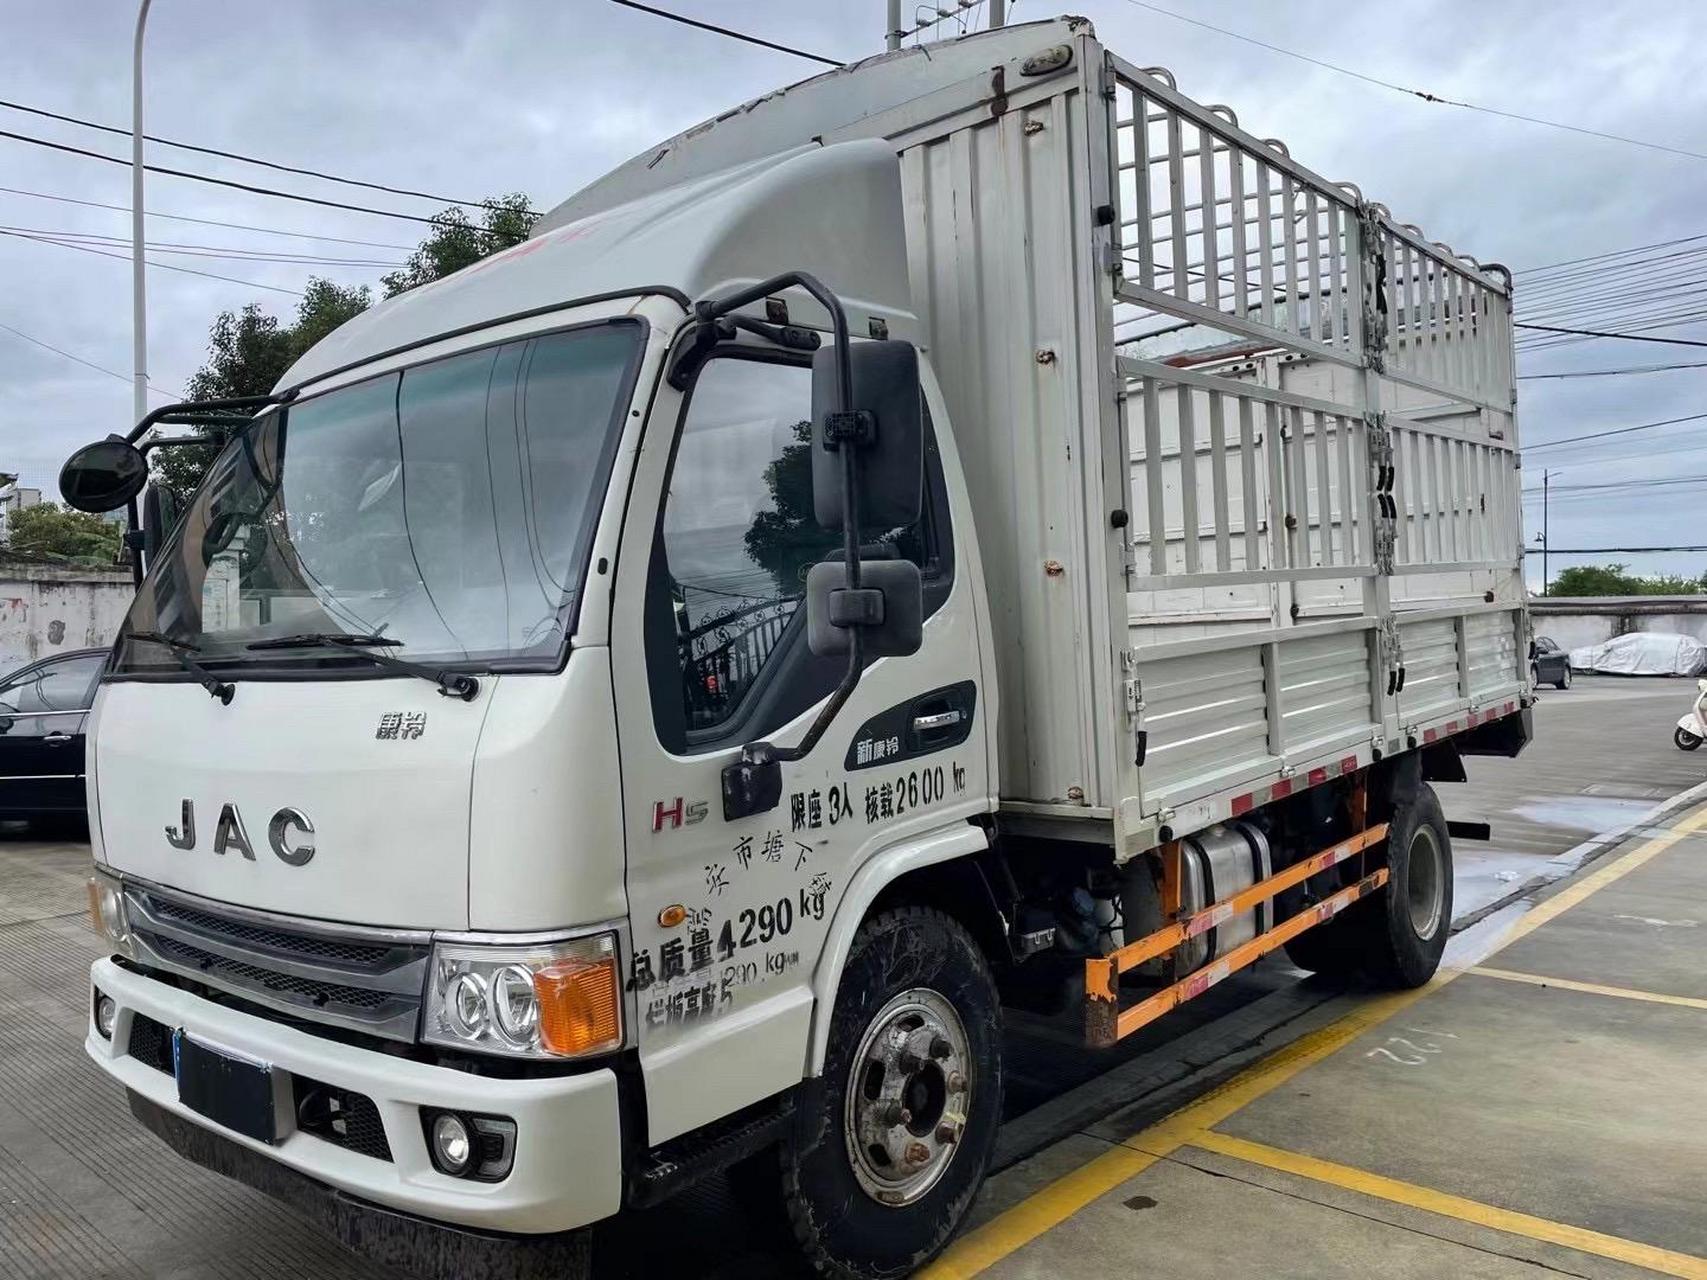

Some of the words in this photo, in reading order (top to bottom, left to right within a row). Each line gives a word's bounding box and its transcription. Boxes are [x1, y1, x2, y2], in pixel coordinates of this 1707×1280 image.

[857, 736, 899, 765] 新康铃
[953, 761, 966, 796] kg
[165, 799, 315, 867] JAC
[799, 888, 825, 920] kg
